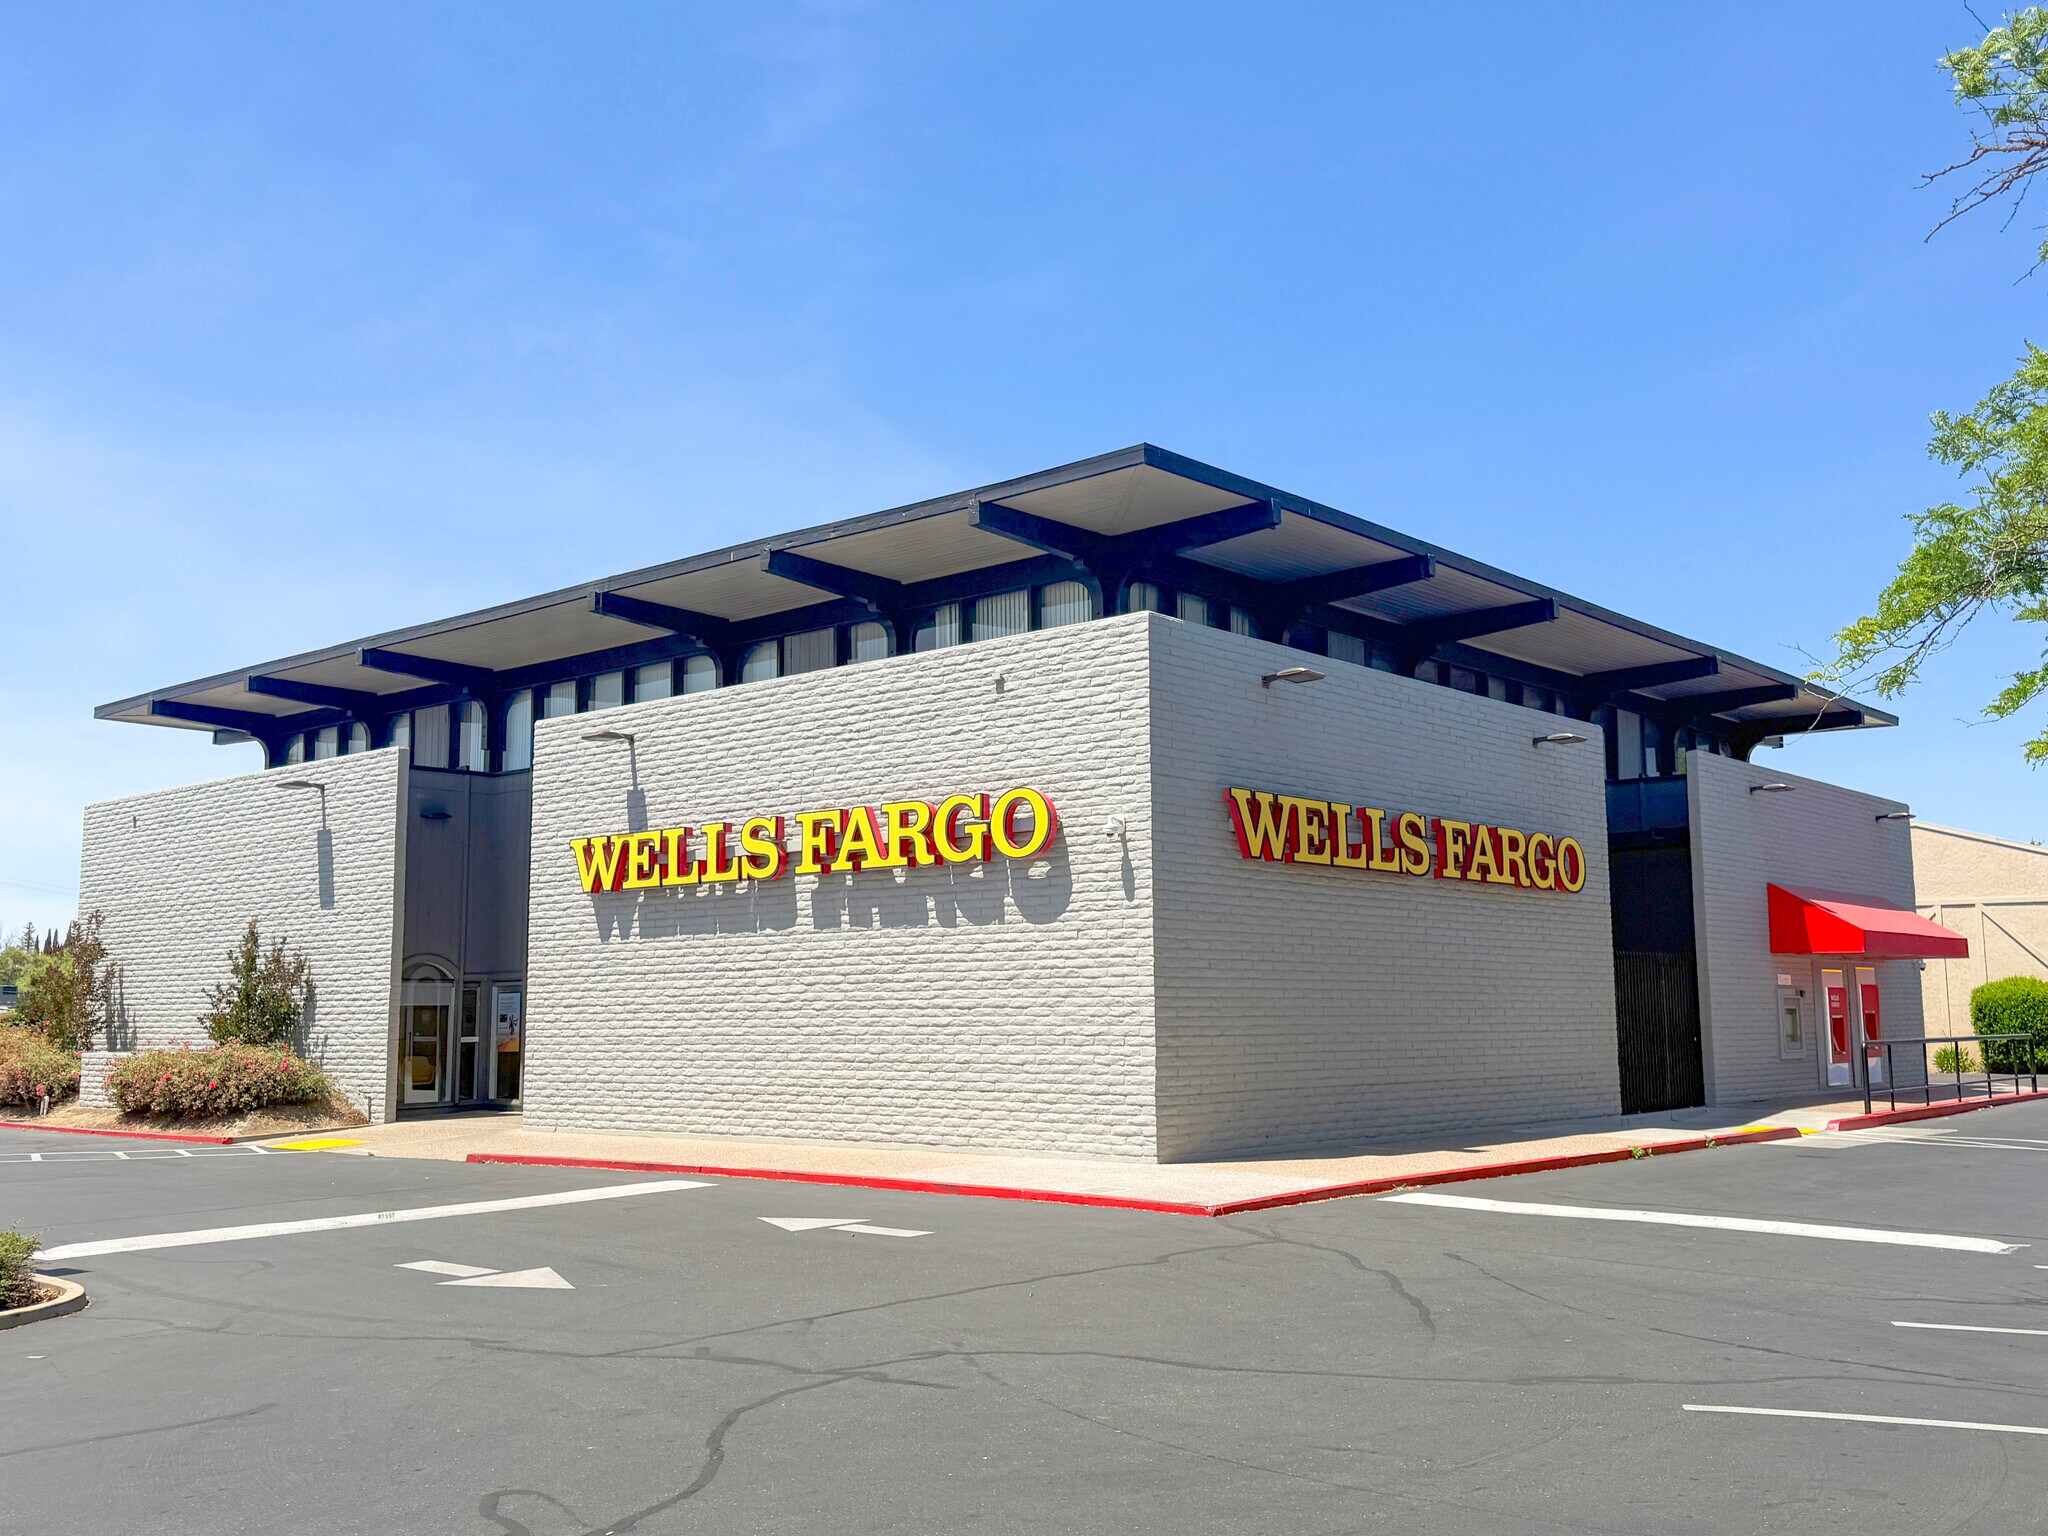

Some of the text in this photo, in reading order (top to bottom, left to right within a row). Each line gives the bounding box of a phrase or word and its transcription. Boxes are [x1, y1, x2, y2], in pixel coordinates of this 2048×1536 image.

[570, 787, 1058, 893] WELLS FARGO
[1223, 787, 1586, 893] WELLS FARGO
